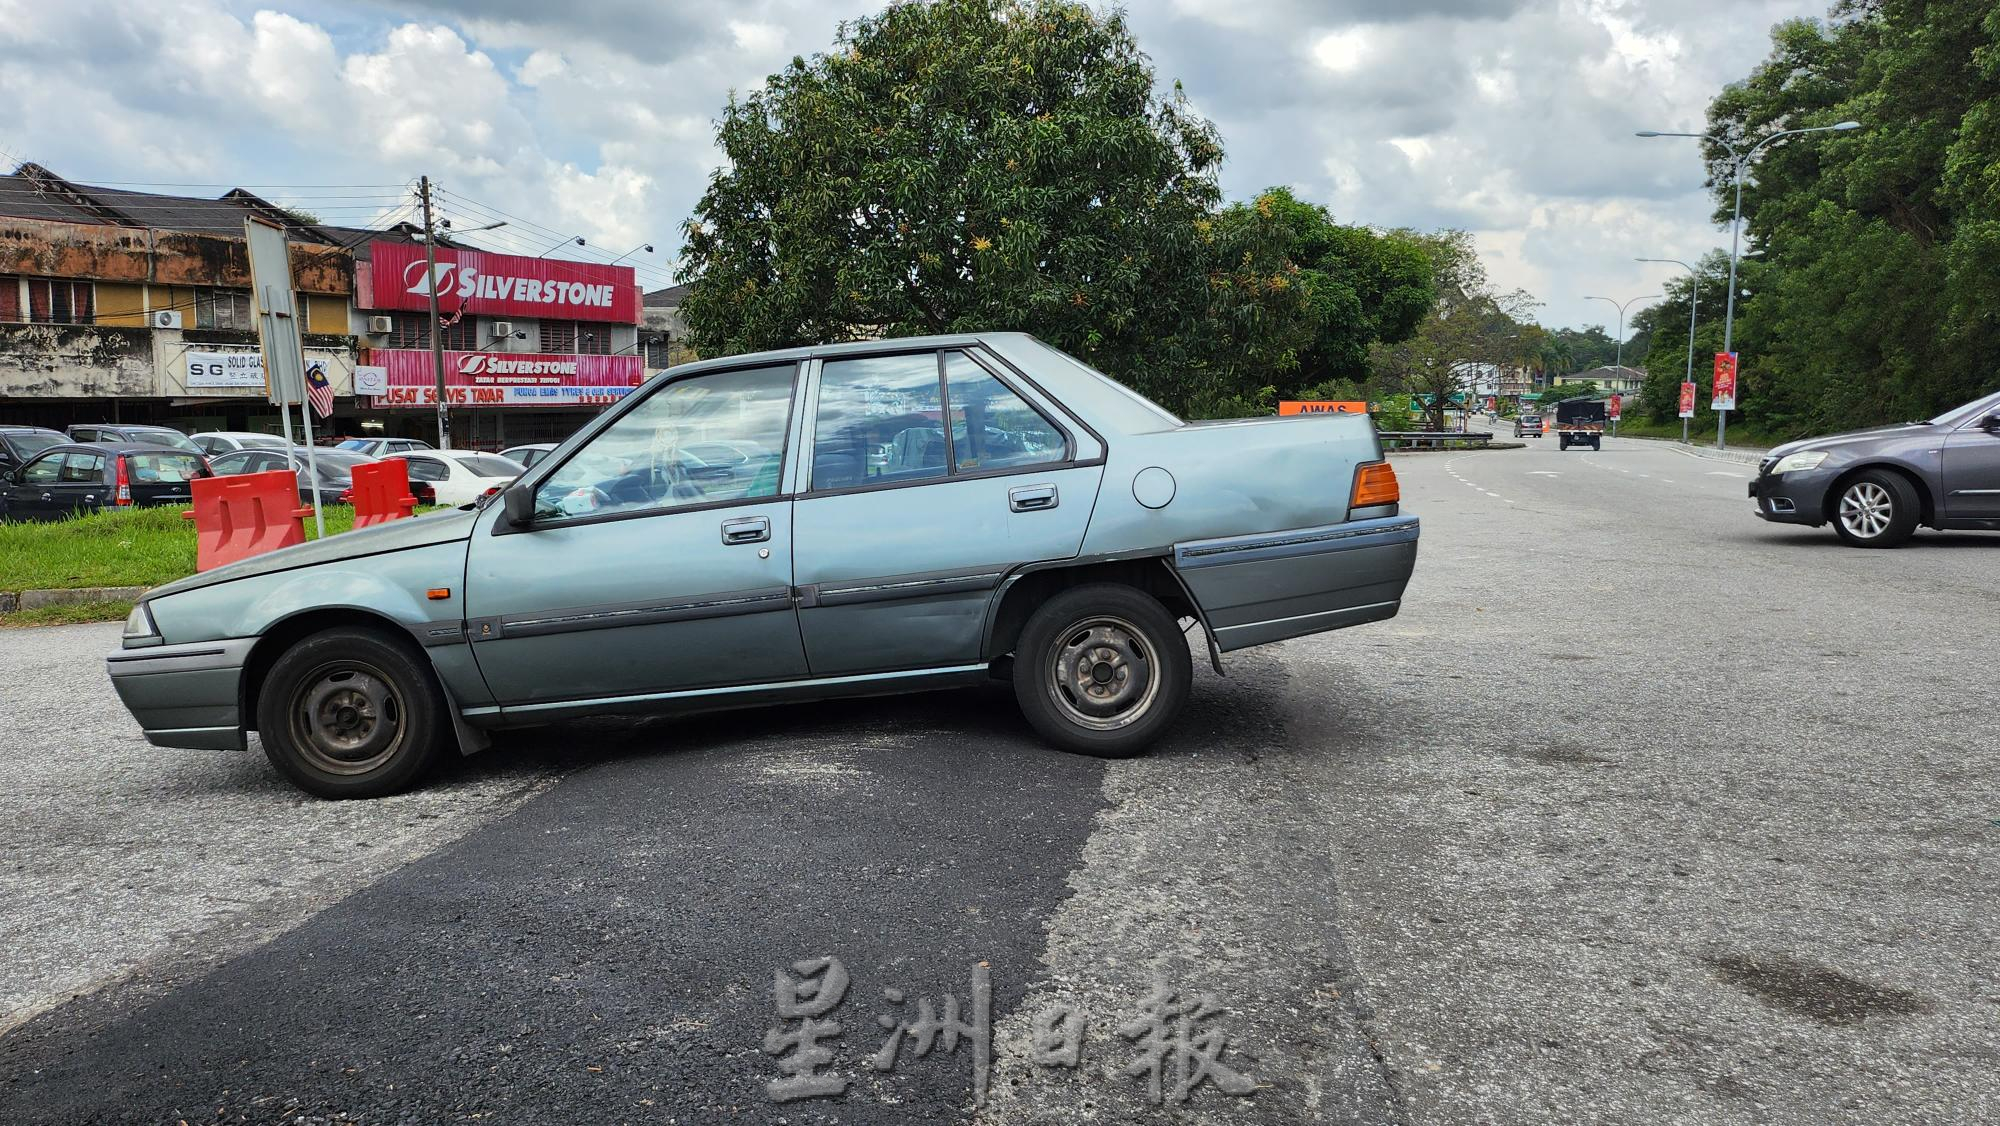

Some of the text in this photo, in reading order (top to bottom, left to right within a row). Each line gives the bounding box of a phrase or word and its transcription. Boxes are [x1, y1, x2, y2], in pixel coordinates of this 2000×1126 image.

[456, 267, 614, 307] SILVERSTONE
[227, 355, 246, 368] SOLID
[486, 357, 577, 375] SILVERSTONE
[423, 388, 467, 404] SEVIS
[471, 388, 504, 403] TAYAR
